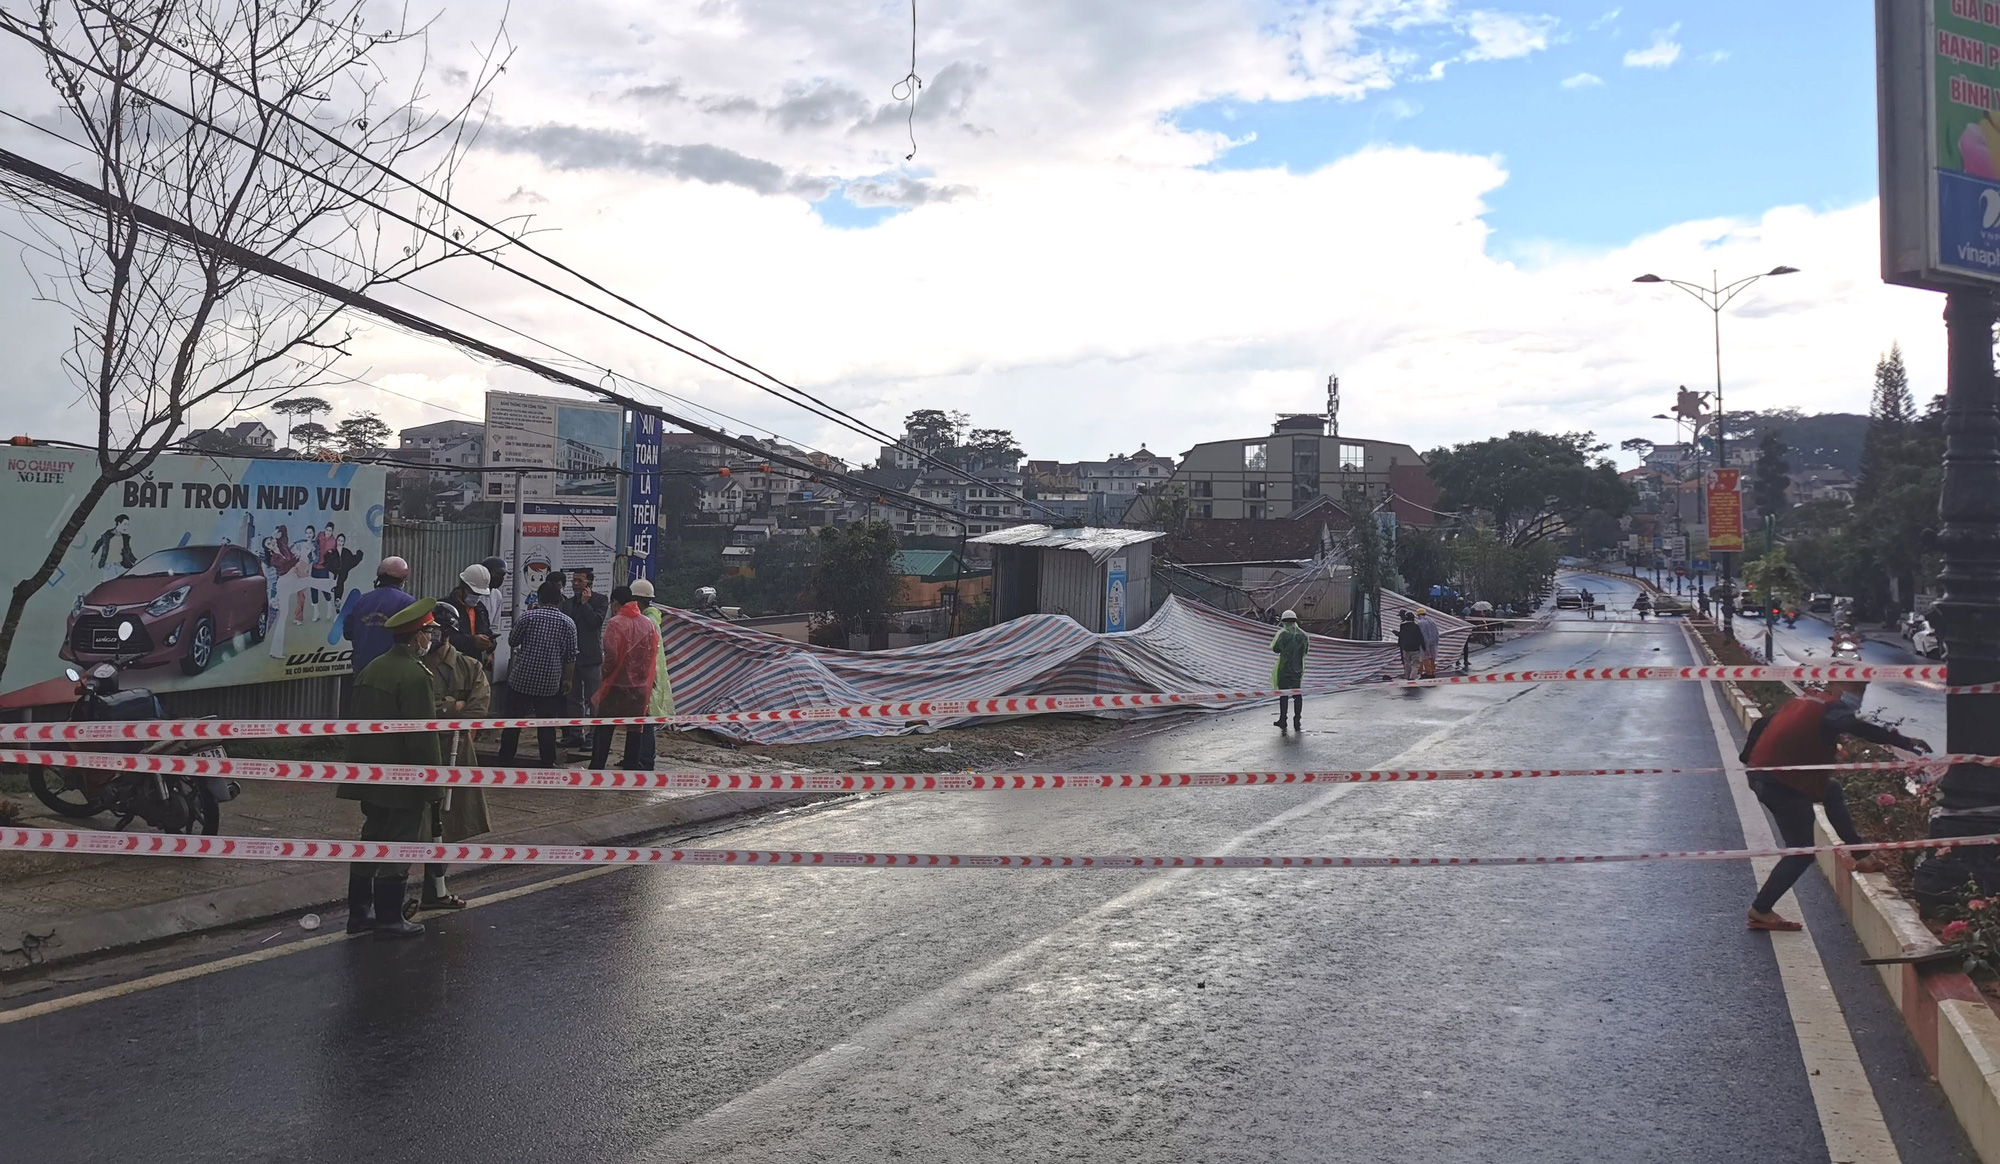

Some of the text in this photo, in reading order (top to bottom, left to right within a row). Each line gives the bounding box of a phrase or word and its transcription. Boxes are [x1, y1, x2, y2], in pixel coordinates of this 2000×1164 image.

[1952, 0, 1979, 21] GIA
[1938, 30, 1983, 64] HẠNH
[1951, 75, 1990, 110] BÌNH
[642, 414, 655, 435] AN
[635, 439, 659, 465] TOÀN
[8, 459, 75, 472] NO QUALITY
[17, 471, 64, 484] NO LIFE
[123, 470, 351, 517] BẮT TRỌN NHỊP VUI
[640, 469, 651, 495] LÀ
[632, 499, 657, 525] TRÊN
[634, 527, 652, 555] HẾT
[331, 663, 345, 671] TOÀN
